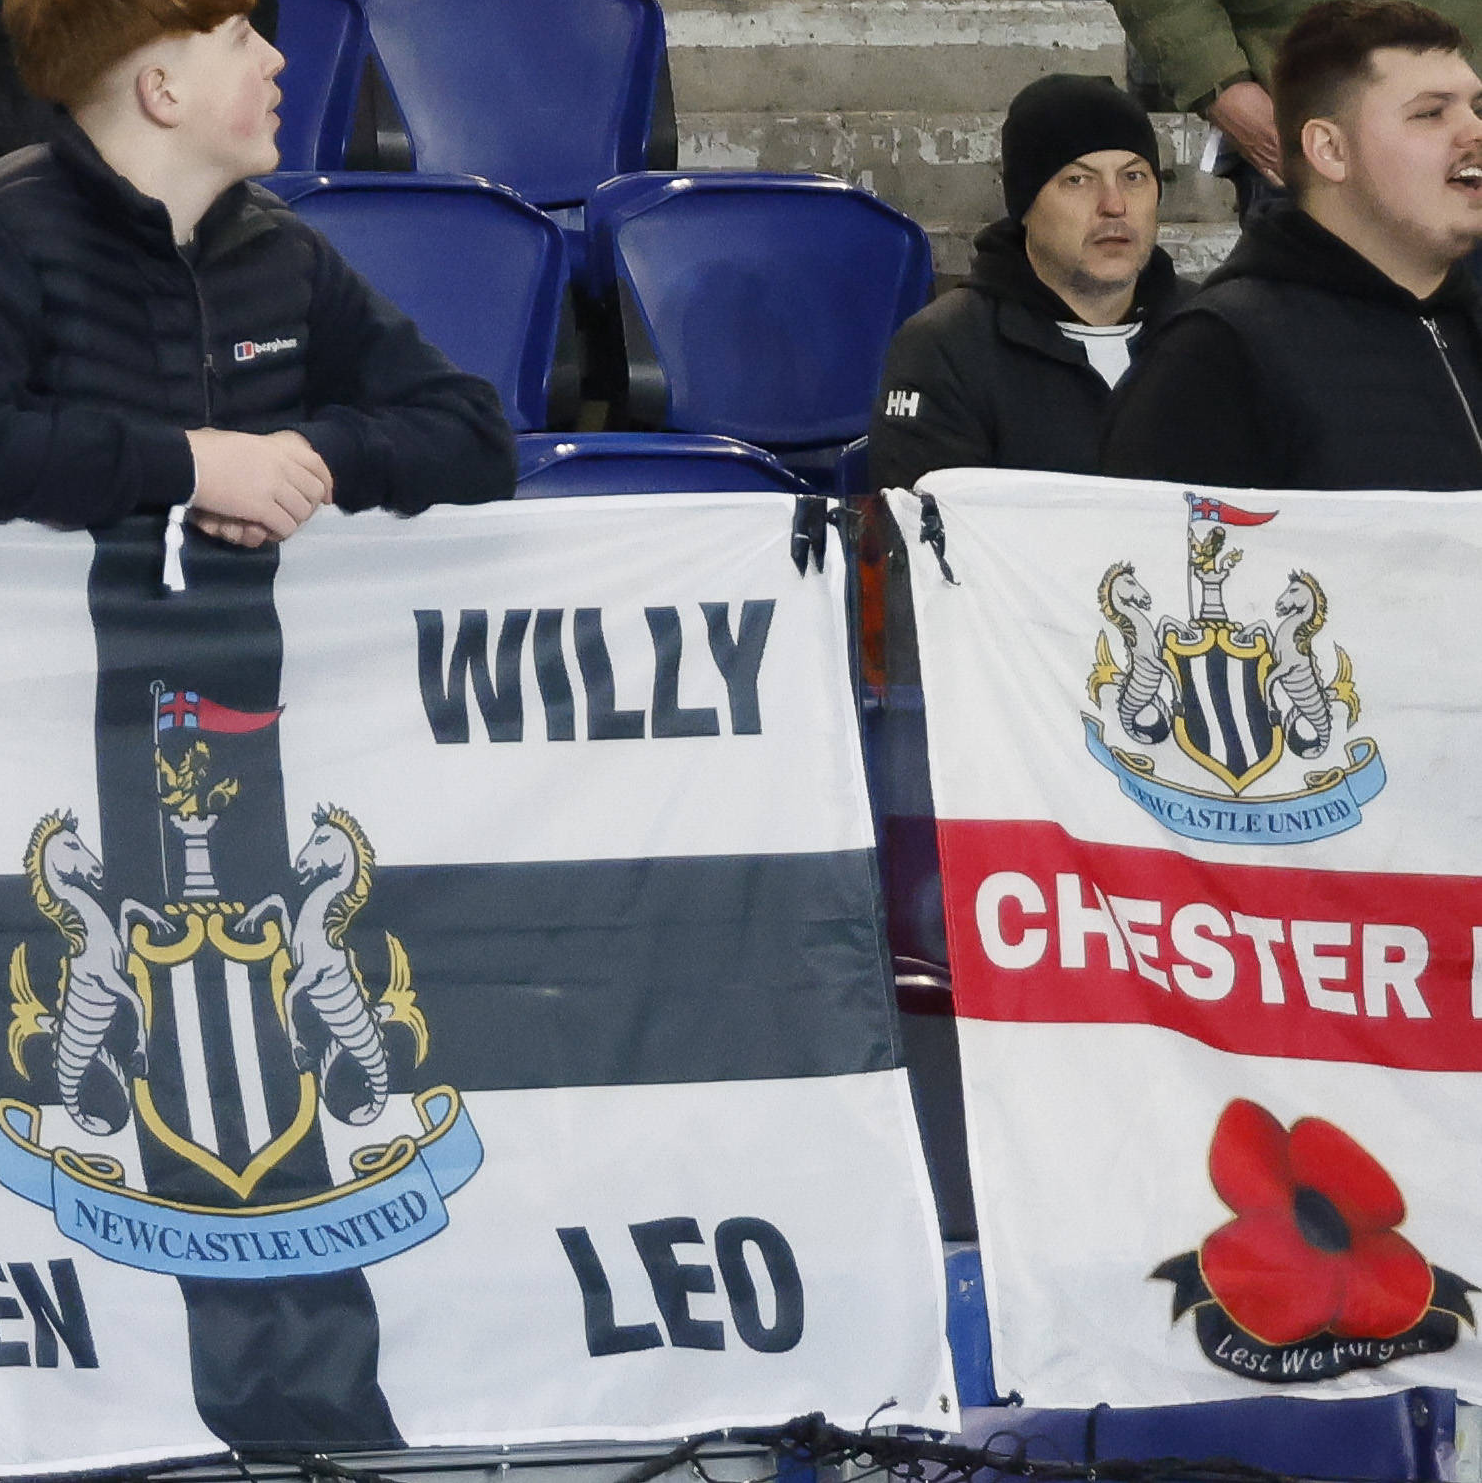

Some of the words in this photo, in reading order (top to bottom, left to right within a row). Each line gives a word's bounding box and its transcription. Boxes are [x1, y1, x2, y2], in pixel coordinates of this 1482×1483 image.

[886, 390, 919, 416] HH
[413, 599, 777, 744] WILLY
[1268, 798, 1351, 833] UNITED
[975, 871, 1435, 1019] CHESTER
[75, 1197, 300, 1262] NEWCASTLE
[299, 1190, 428, 1256] UNITED
[556, 1216, 805, 1357] LEO
[1281, 1346, 1323, 1375] We
